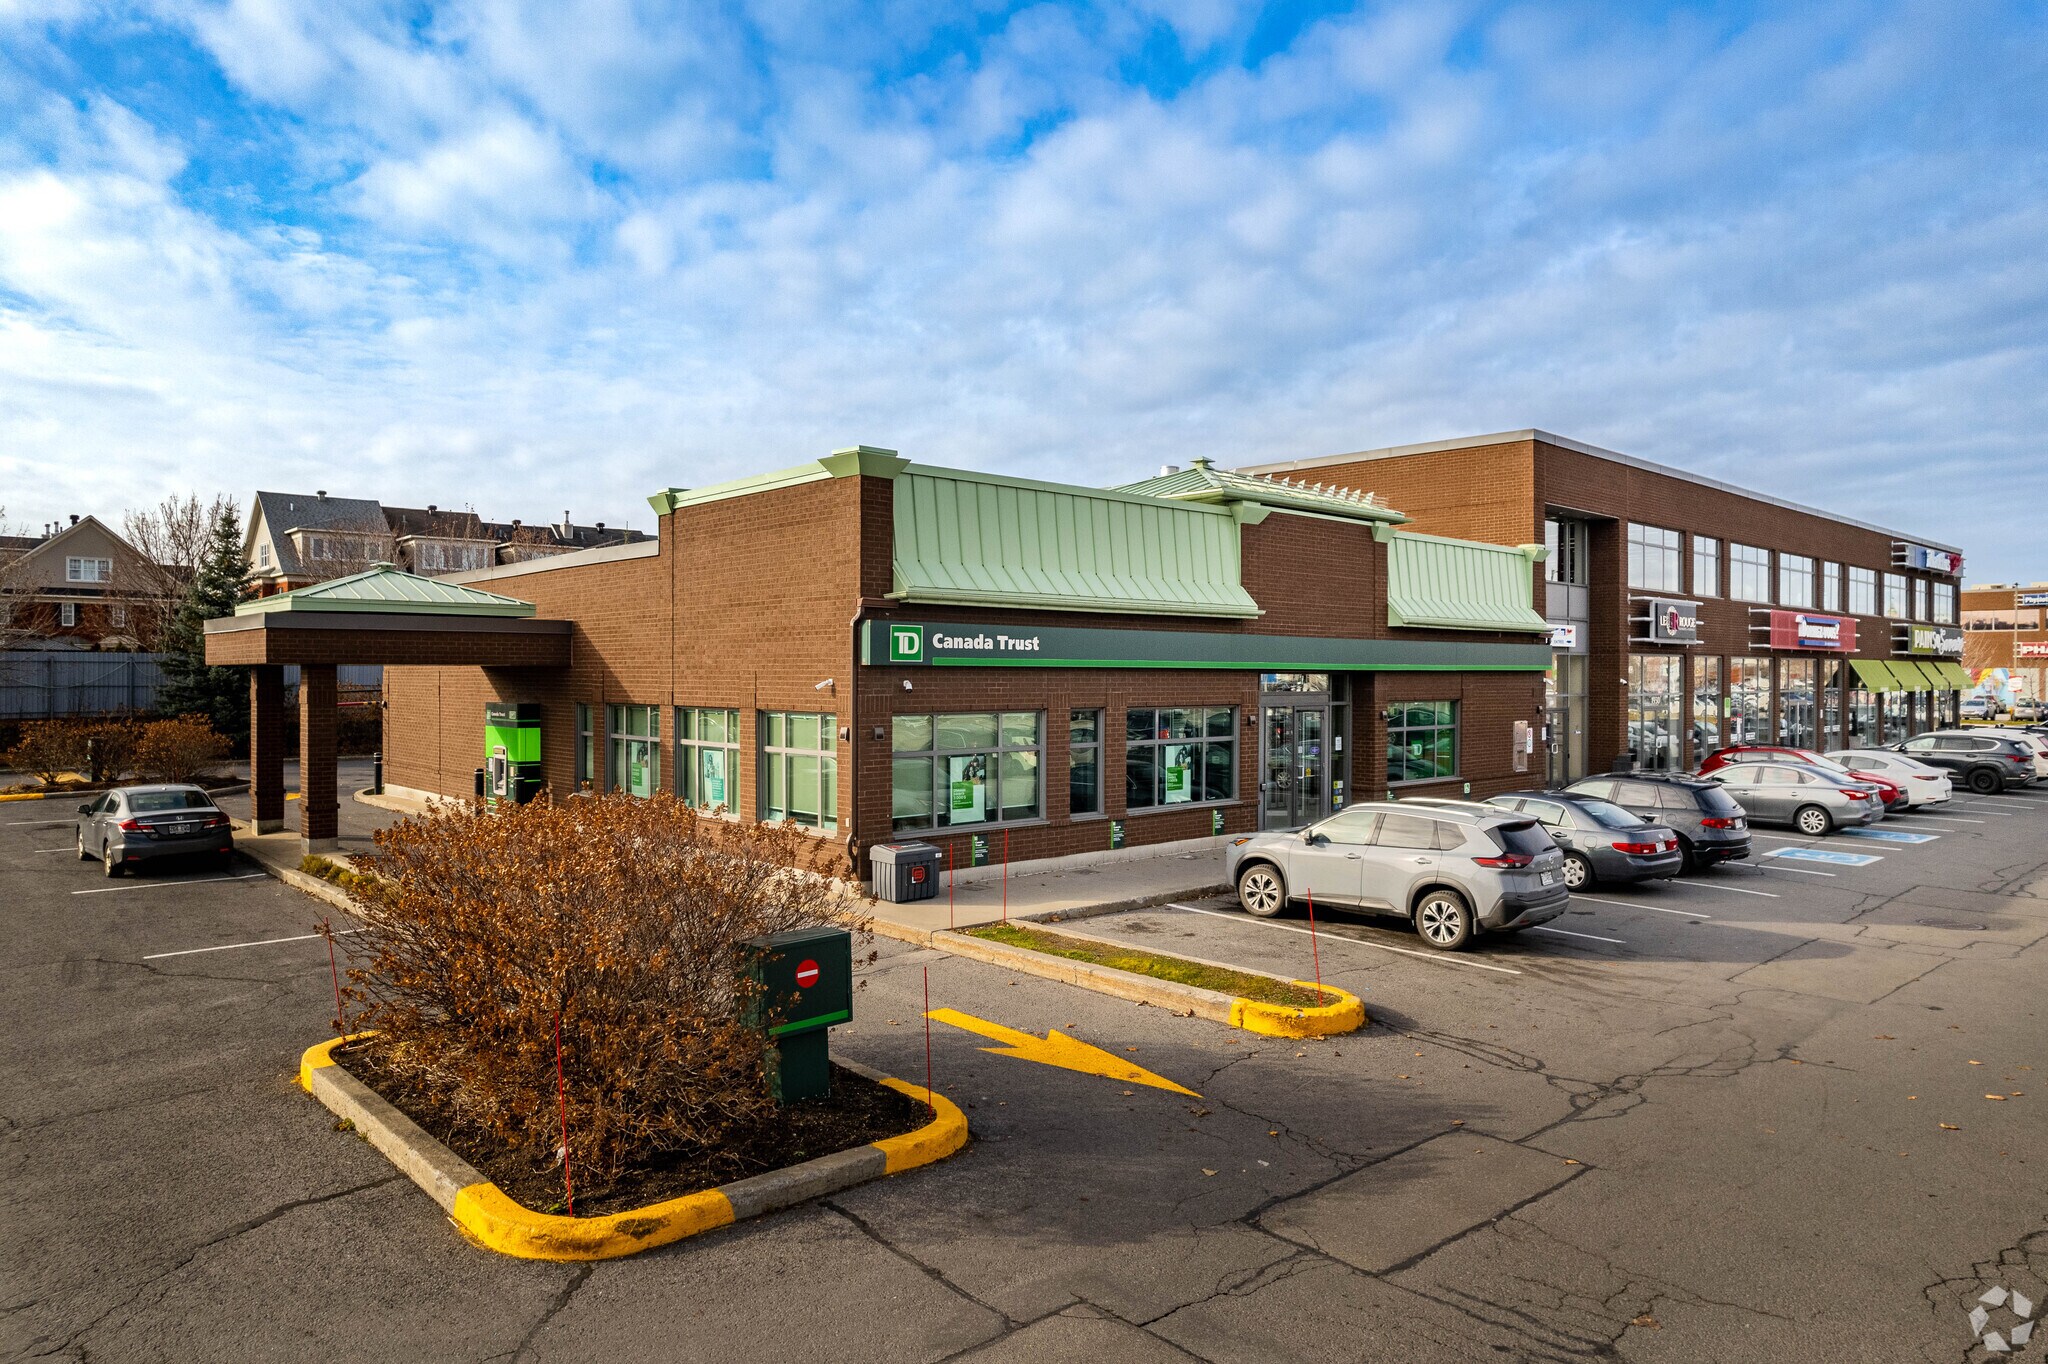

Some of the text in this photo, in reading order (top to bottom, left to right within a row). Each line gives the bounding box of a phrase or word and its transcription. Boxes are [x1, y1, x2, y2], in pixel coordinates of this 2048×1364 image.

[894, 632, 1039, 654] TD Canada Trust
